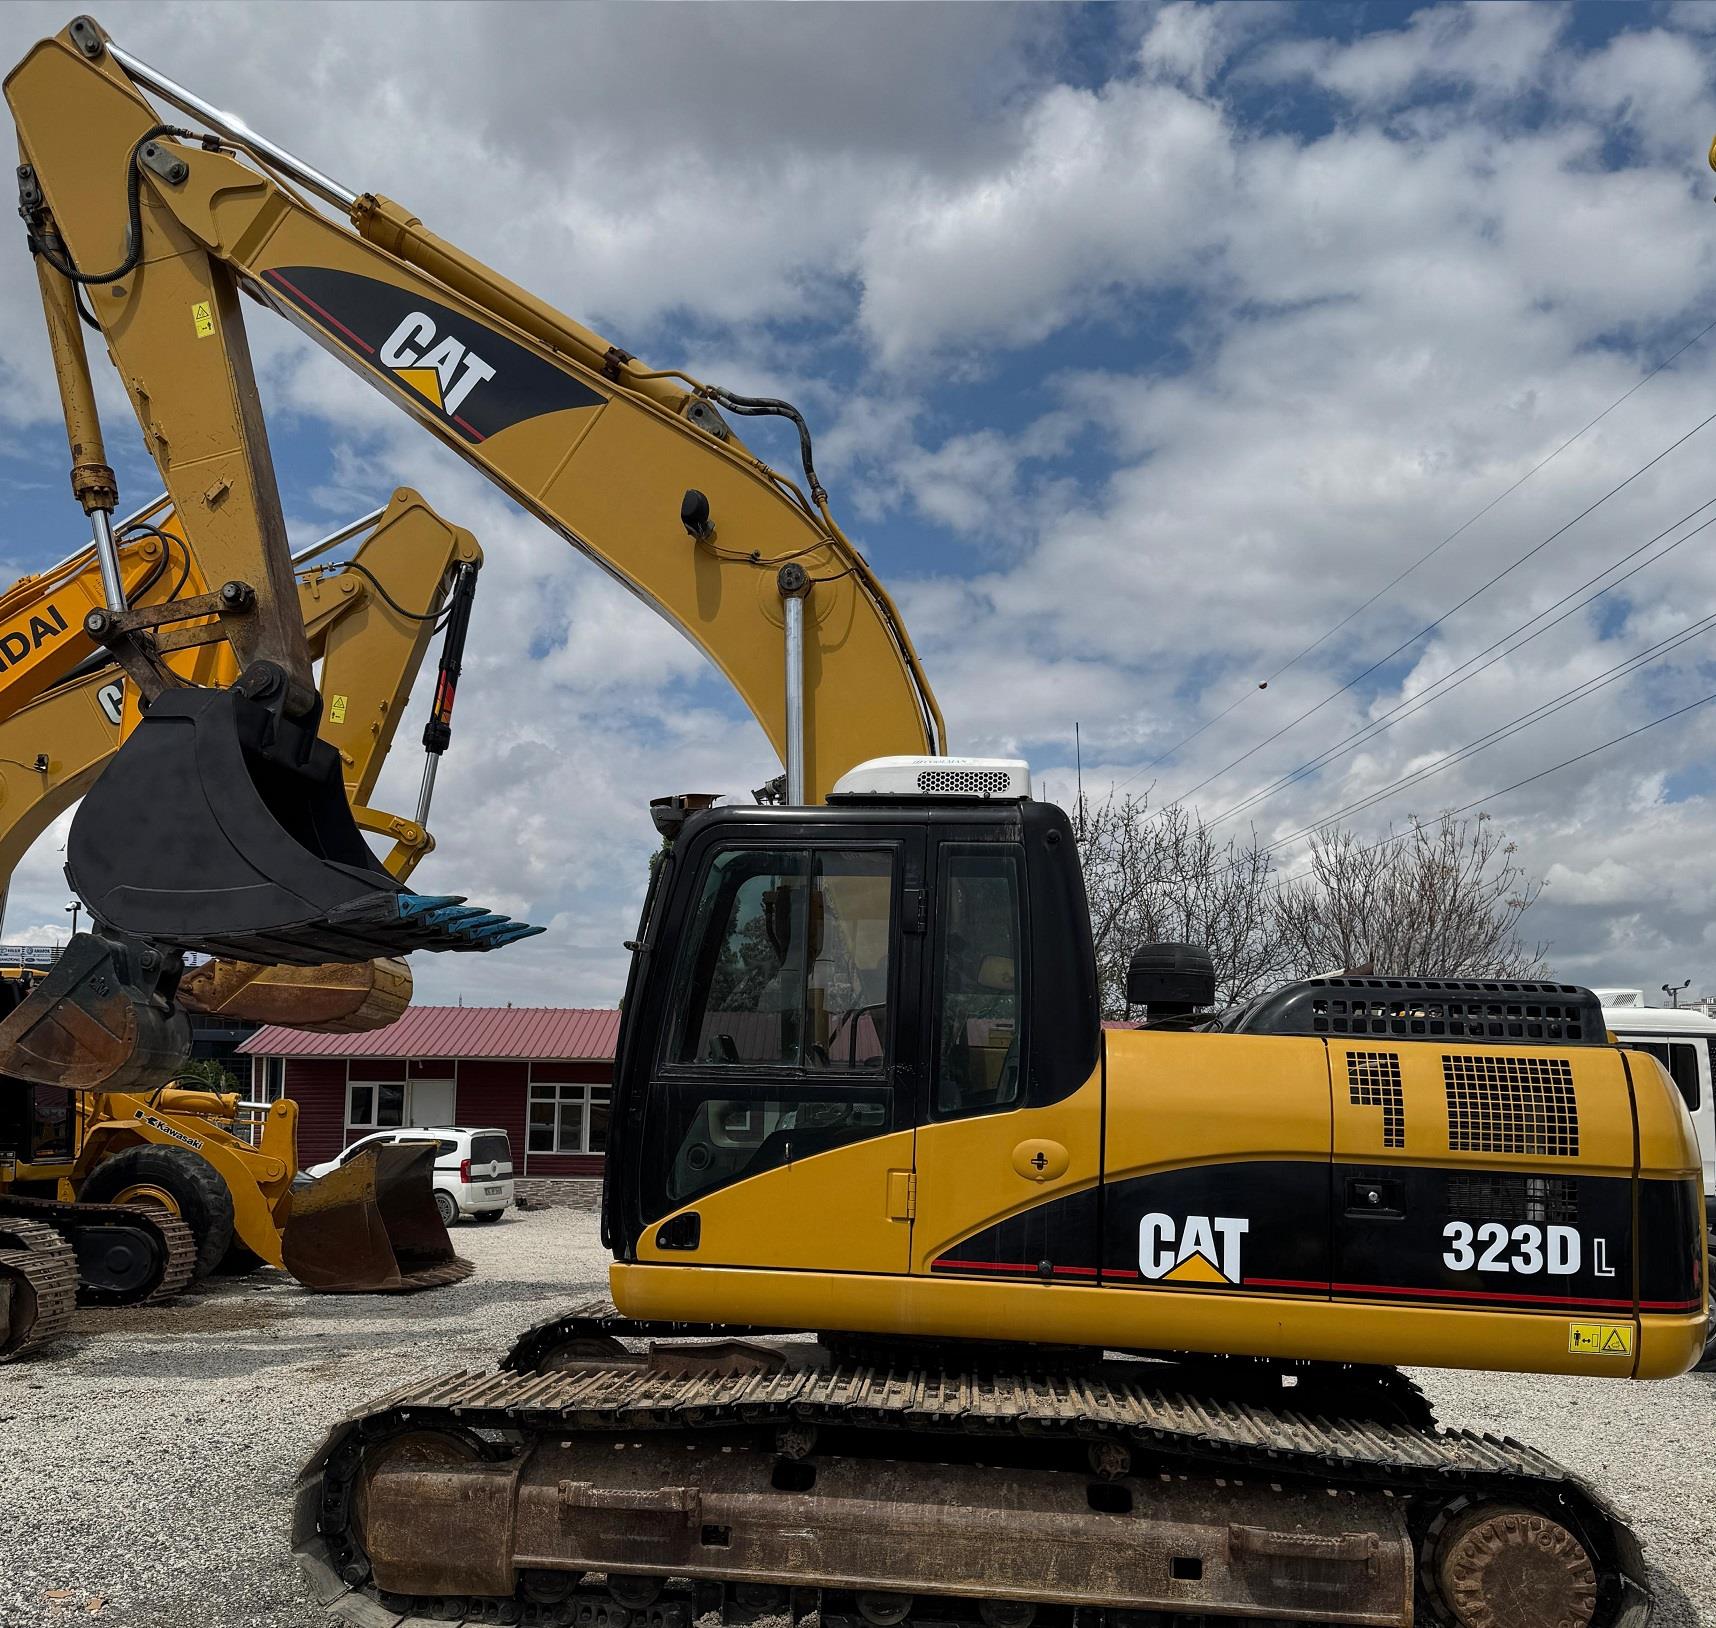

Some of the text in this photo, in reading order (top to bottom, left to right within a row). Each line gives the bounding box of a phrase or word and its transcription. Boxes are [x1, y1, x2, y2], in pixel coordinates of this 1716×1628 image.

[380, 311, 497, 416] CAT
[156, 1121, 203, 1150] Kawasaki
[1138, 1212, 1249, 1284] CAT
[1442, 1221, 1616, 1277] 323D L
